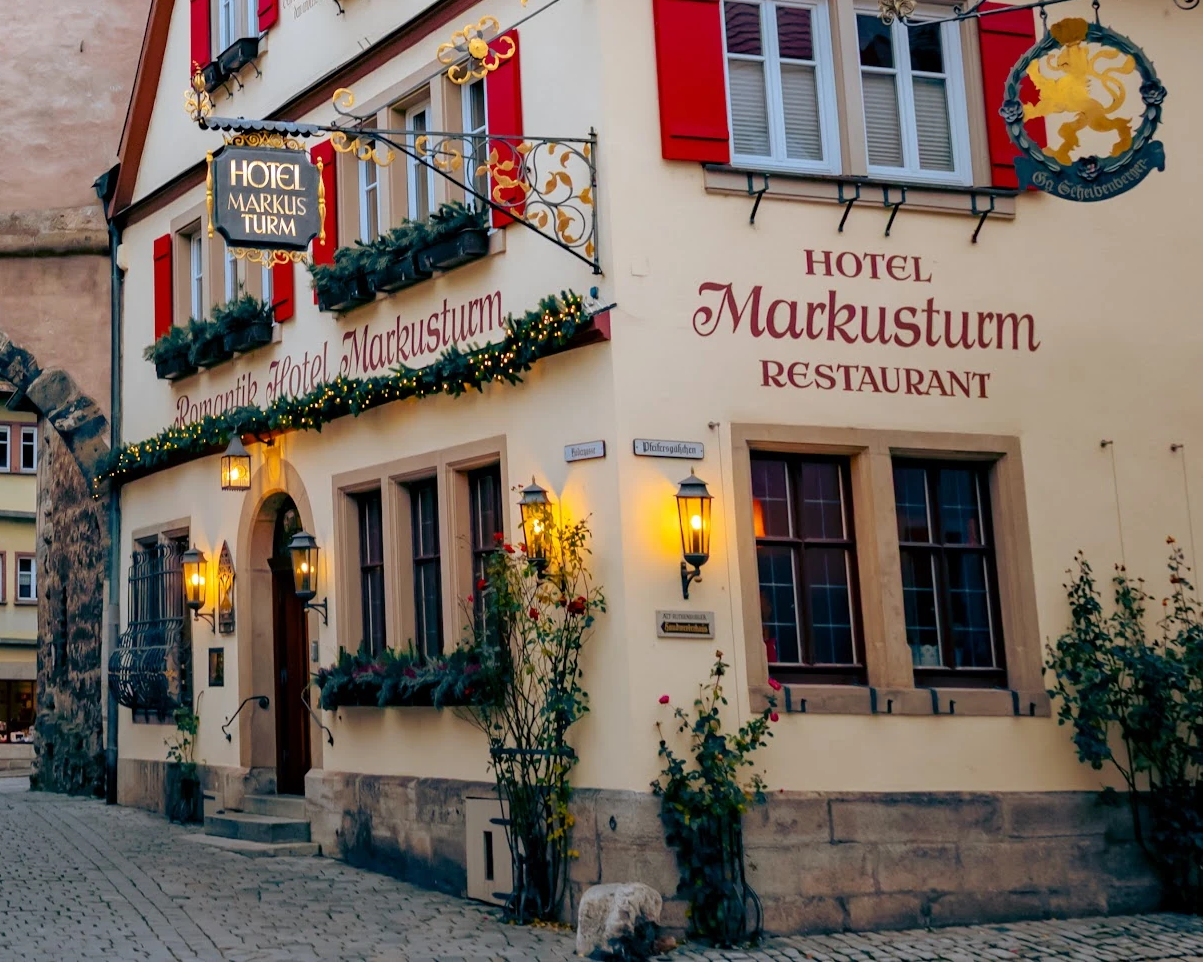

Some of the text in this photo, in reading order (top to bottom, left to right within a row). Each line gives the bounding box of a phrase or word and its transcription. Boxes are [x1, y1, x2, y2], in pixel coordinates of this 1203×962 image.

[230, 159, 305, 191] HOTEL
[228, 193, 307, 215] MARKUS
[241, 213, 296, 236] TURM
[804, 249, 932, 283] HOTEL
[693, 281, 1041, 353] Markusturm
[174, 290, 506, 427] Romantik Hotel Markusturm
[759, 359, 991, 399] RESTAURANT
